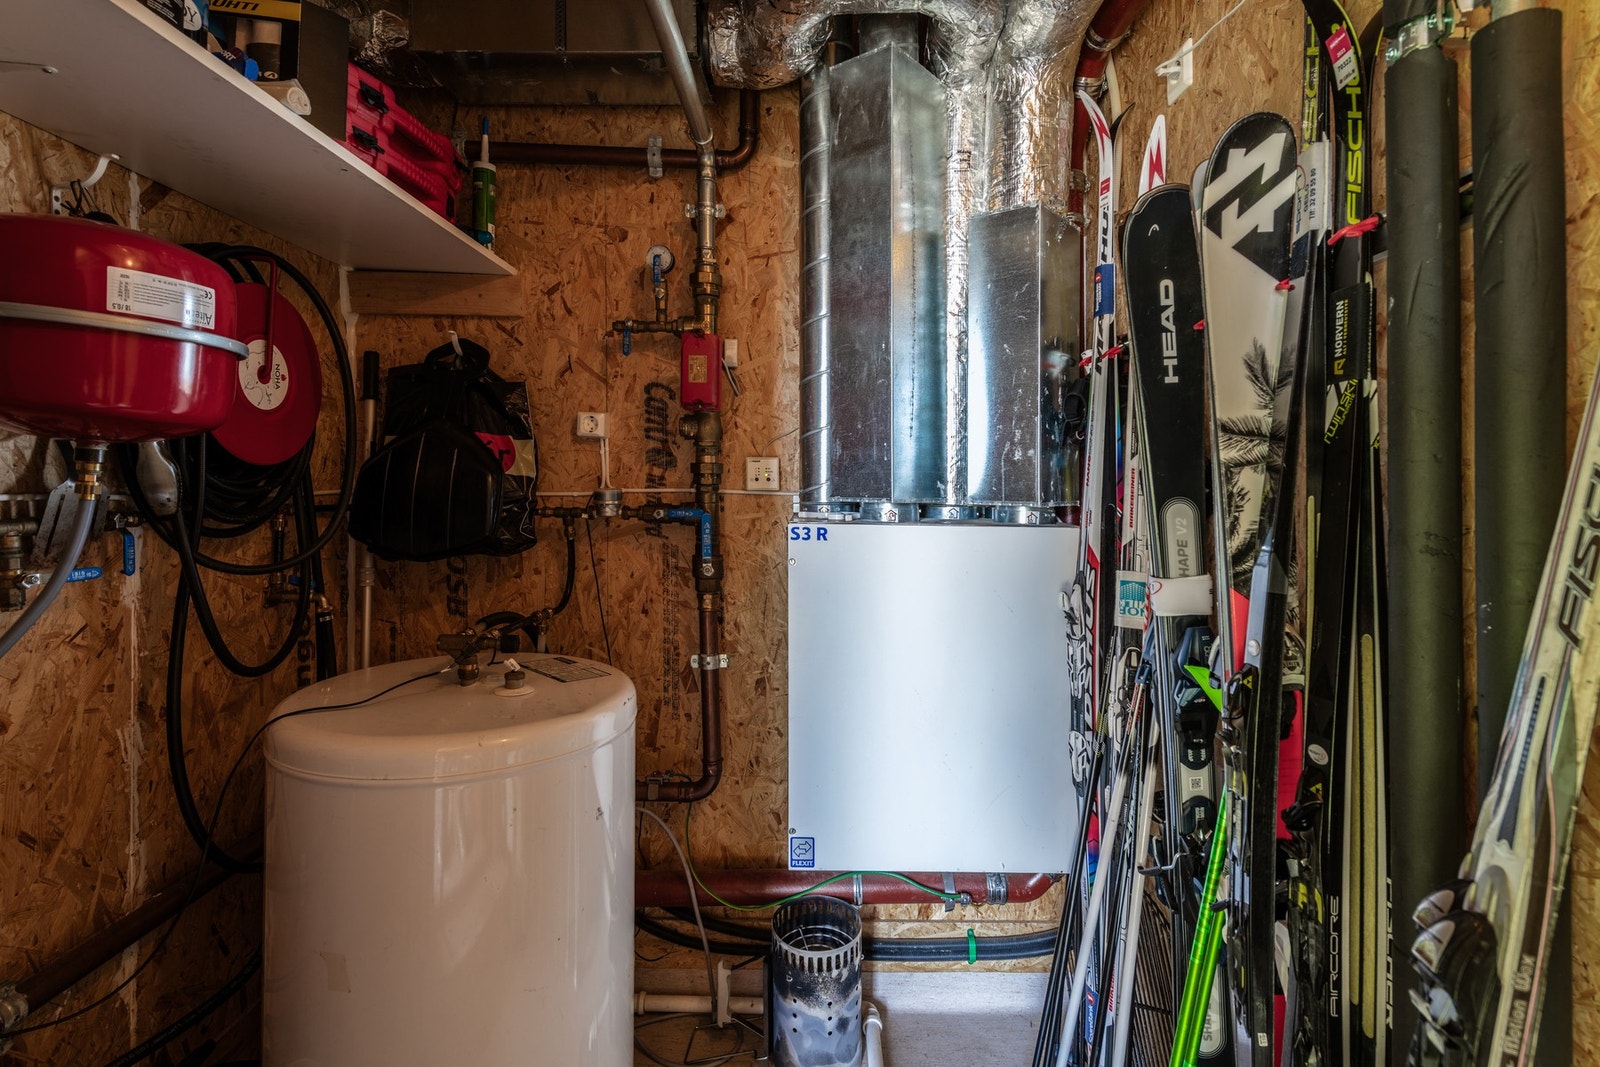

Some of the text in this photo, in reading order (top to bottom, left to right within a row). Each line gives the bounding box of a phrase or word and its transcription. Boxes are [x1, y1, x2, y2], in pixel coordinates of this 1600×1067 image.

[1159, 278, 1179, 384] HEAD
[1334, 299, 1344, 358] NORVERN
[790, 526, 828, 541] S3 R
[1175, 517, 1190, 577] HAPE V2
[1329, 895, 1339, 1017] AIRCORE
